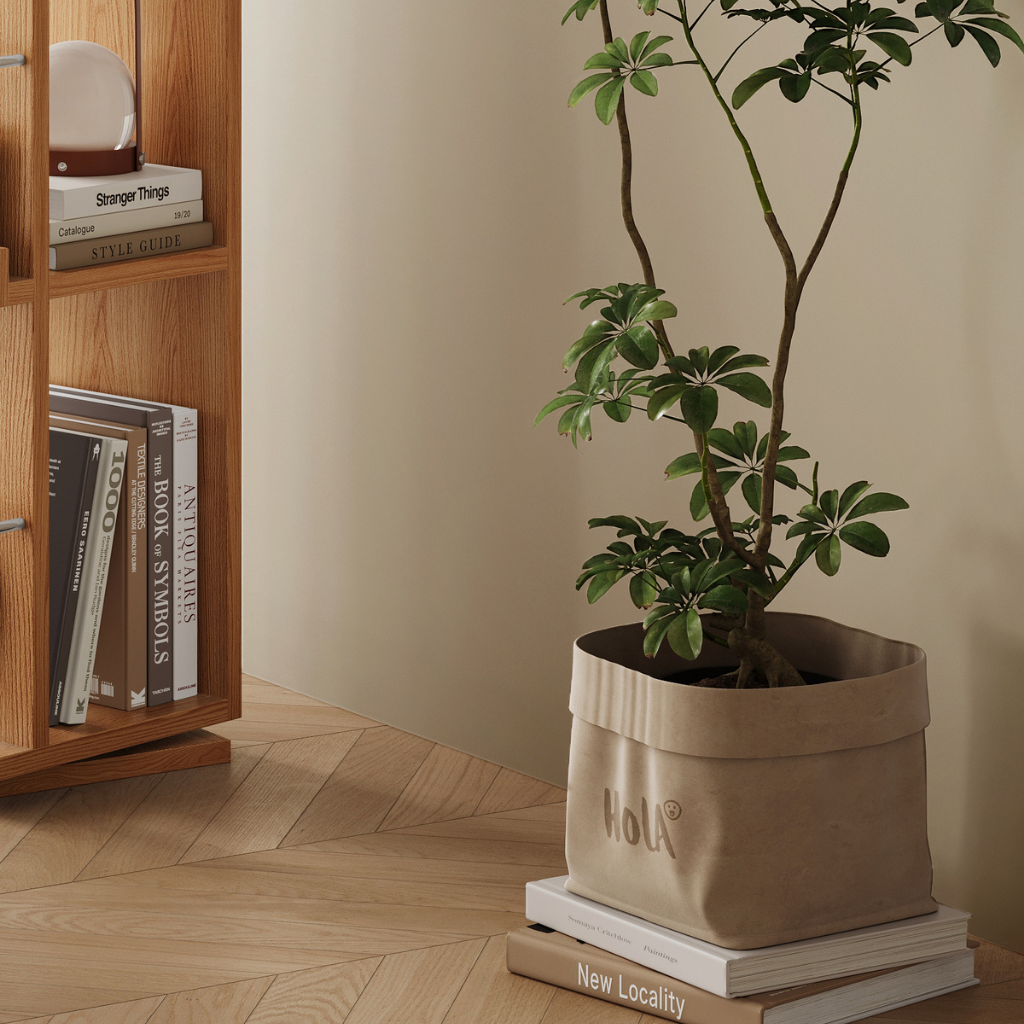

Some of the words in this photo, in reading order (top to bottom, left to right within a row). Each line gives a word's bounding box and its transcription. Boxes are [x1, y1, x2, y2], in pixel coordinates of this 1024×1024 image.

[96, 189, 137, 207] Stranger
[137, 185, 170, 202] Things
[174, 210, 191, 220] 19/20
[58, 224, 95, 238] Catalogue
[91, 242, 134, 260] STYLE
[139, 234, 182, 253] GUIDE
[137, 442, 146, 478] TEXTILE
[154, 454, 162, 476] THE
[102, 450, 125, 533] 1000
[137, 480, 146, 530] DESIGNERS
[154, 478, 169, 540] BOOK
[81, 511, 90, 537] EERO
[72, 540, 85, 592] SAARINEN
[154, 543, 162, 557] OF
[182, 483, 196, 624] ANTIQUAIRES
[154, 560, 169, 665] SYMBOLS
[567, 915, 596, 931] Somaya
[597, 926, 632, 945] Critchlow
[643, 945, 678, 964] Paintings
[578, 962, 613, 994] New
[619, 974, 685, 1021] Locality
